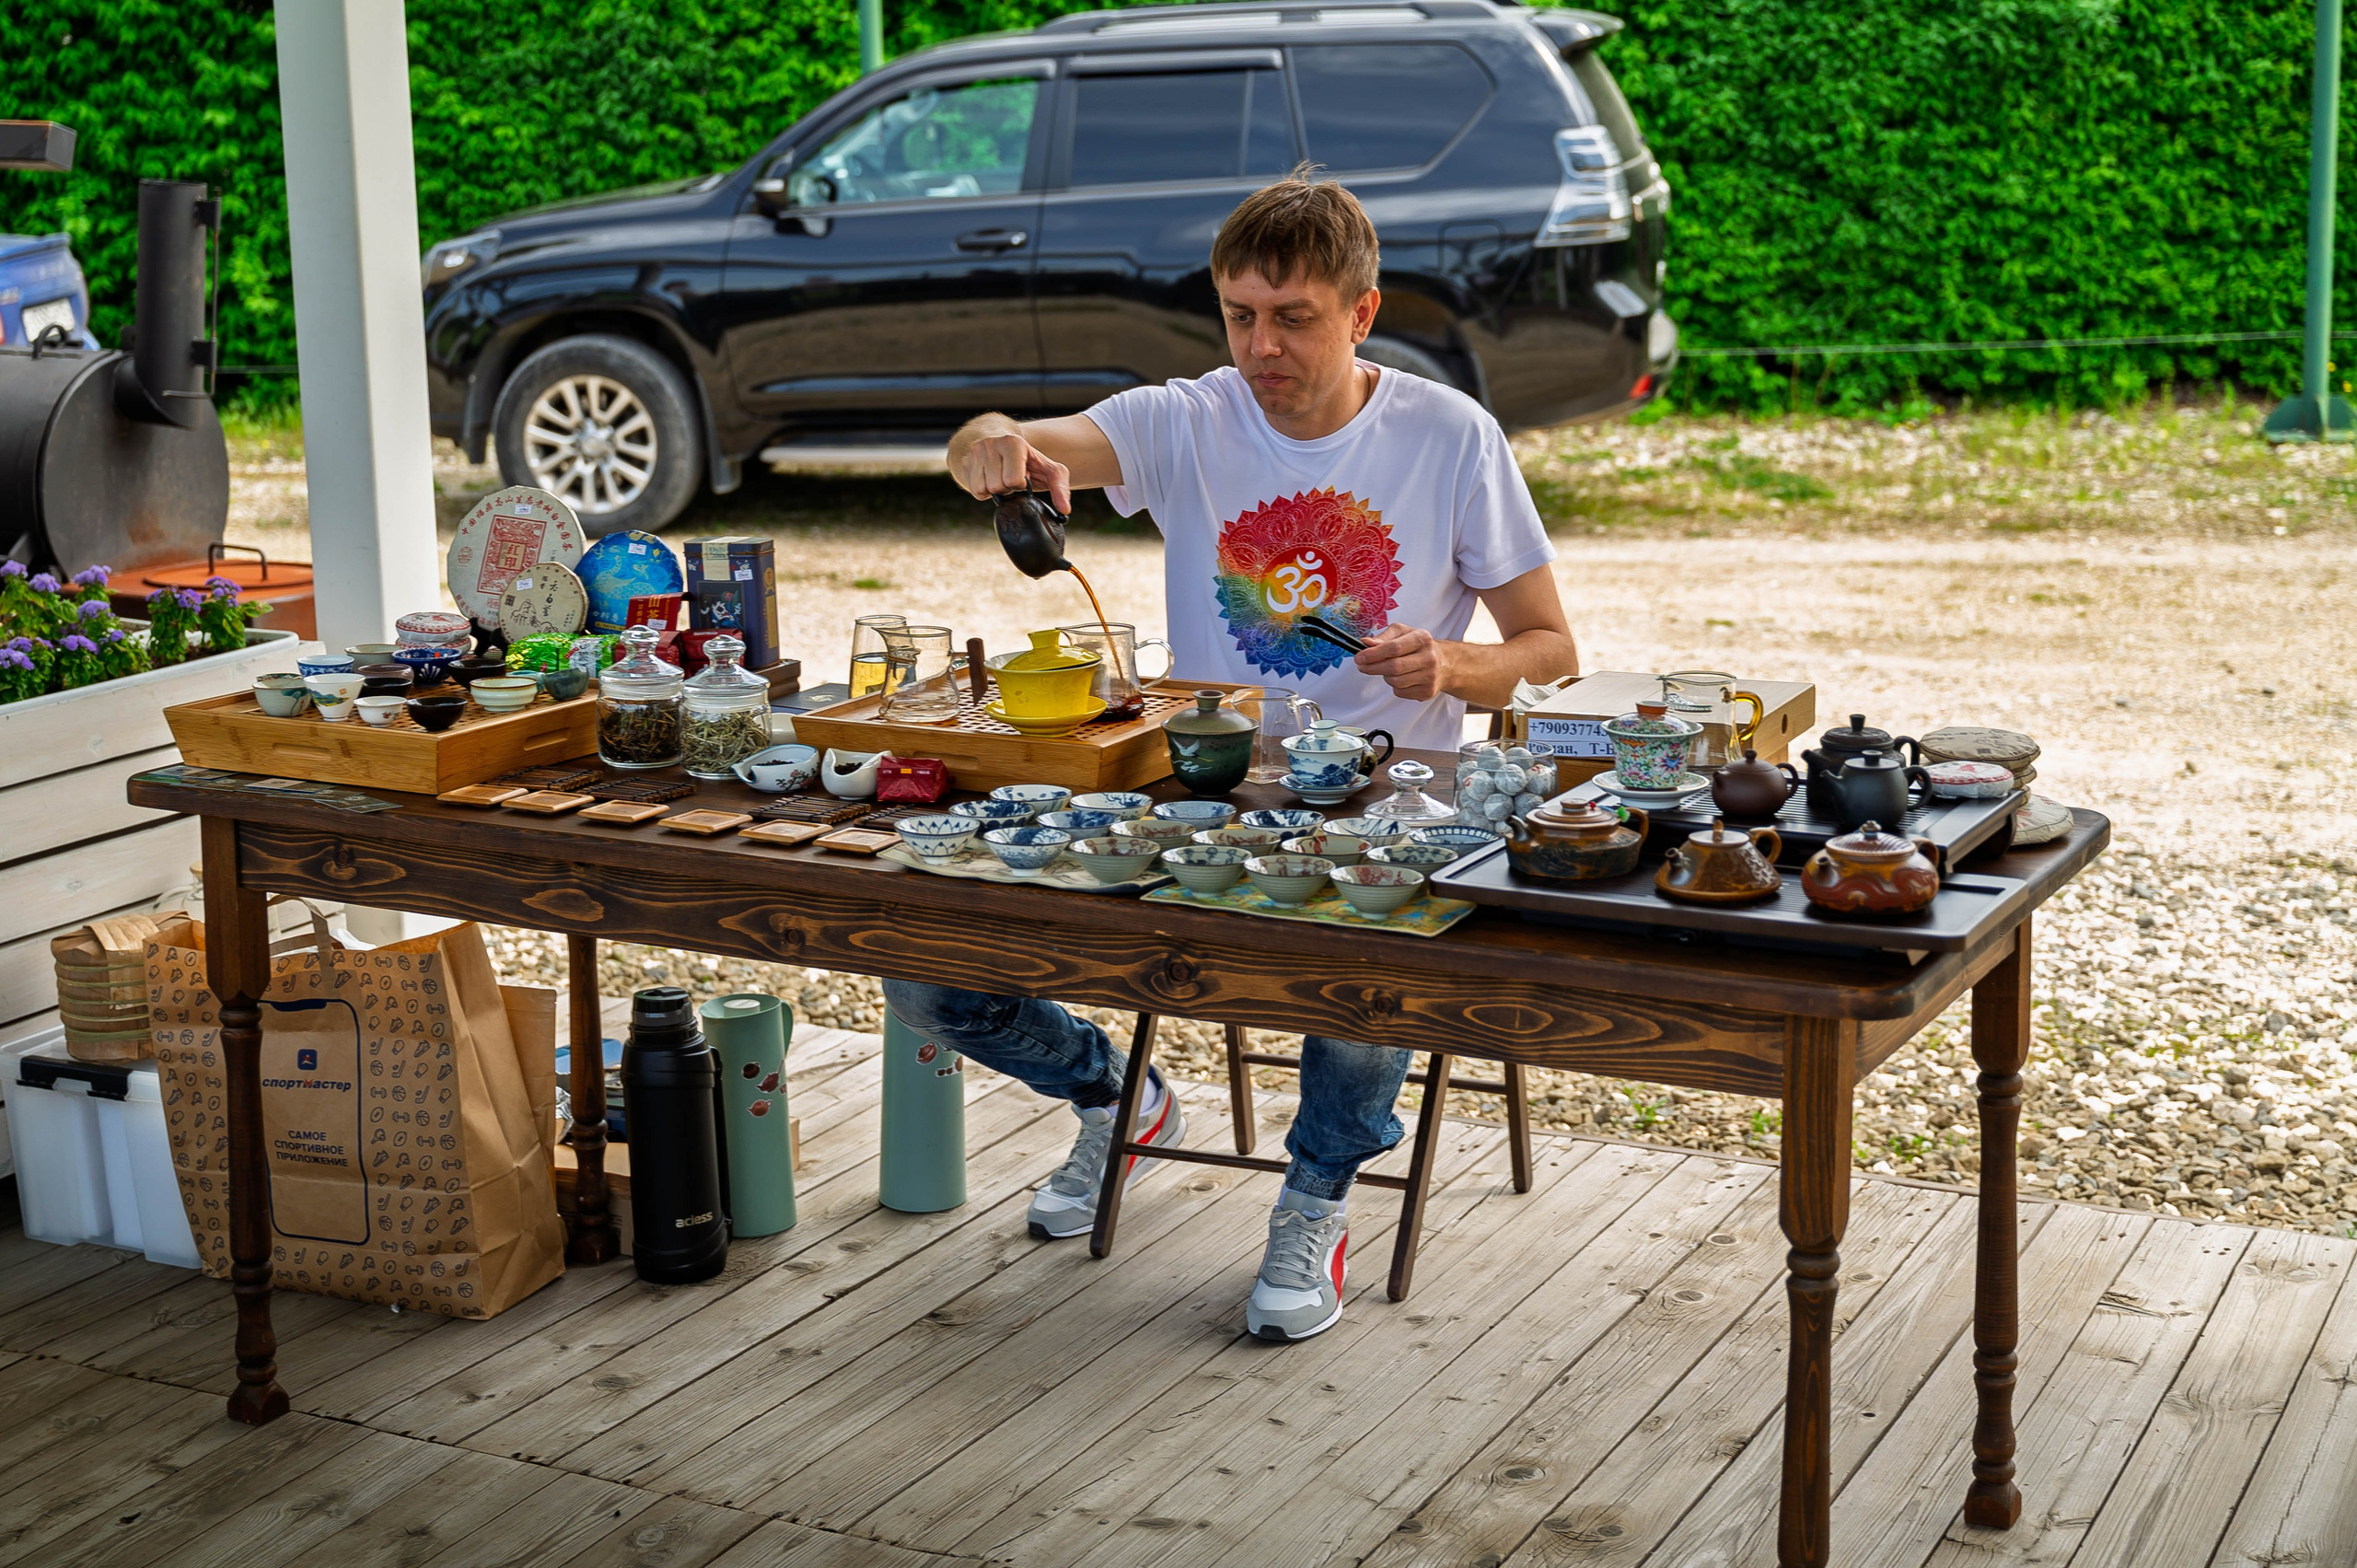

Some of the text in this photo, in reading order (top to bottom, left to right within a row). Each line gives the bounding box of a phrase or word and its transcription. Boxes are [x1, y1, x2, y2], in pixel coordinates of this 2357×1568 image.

[261, 1078, 351, 1092] спортмастер
[288, 1130, 326, 1141] САМОЕ
[274, 1140, 343, 1155] СПОРТИВНОЕ
[276, 1152, 348, 1167] ПРИЛОЖЕНИЕ
